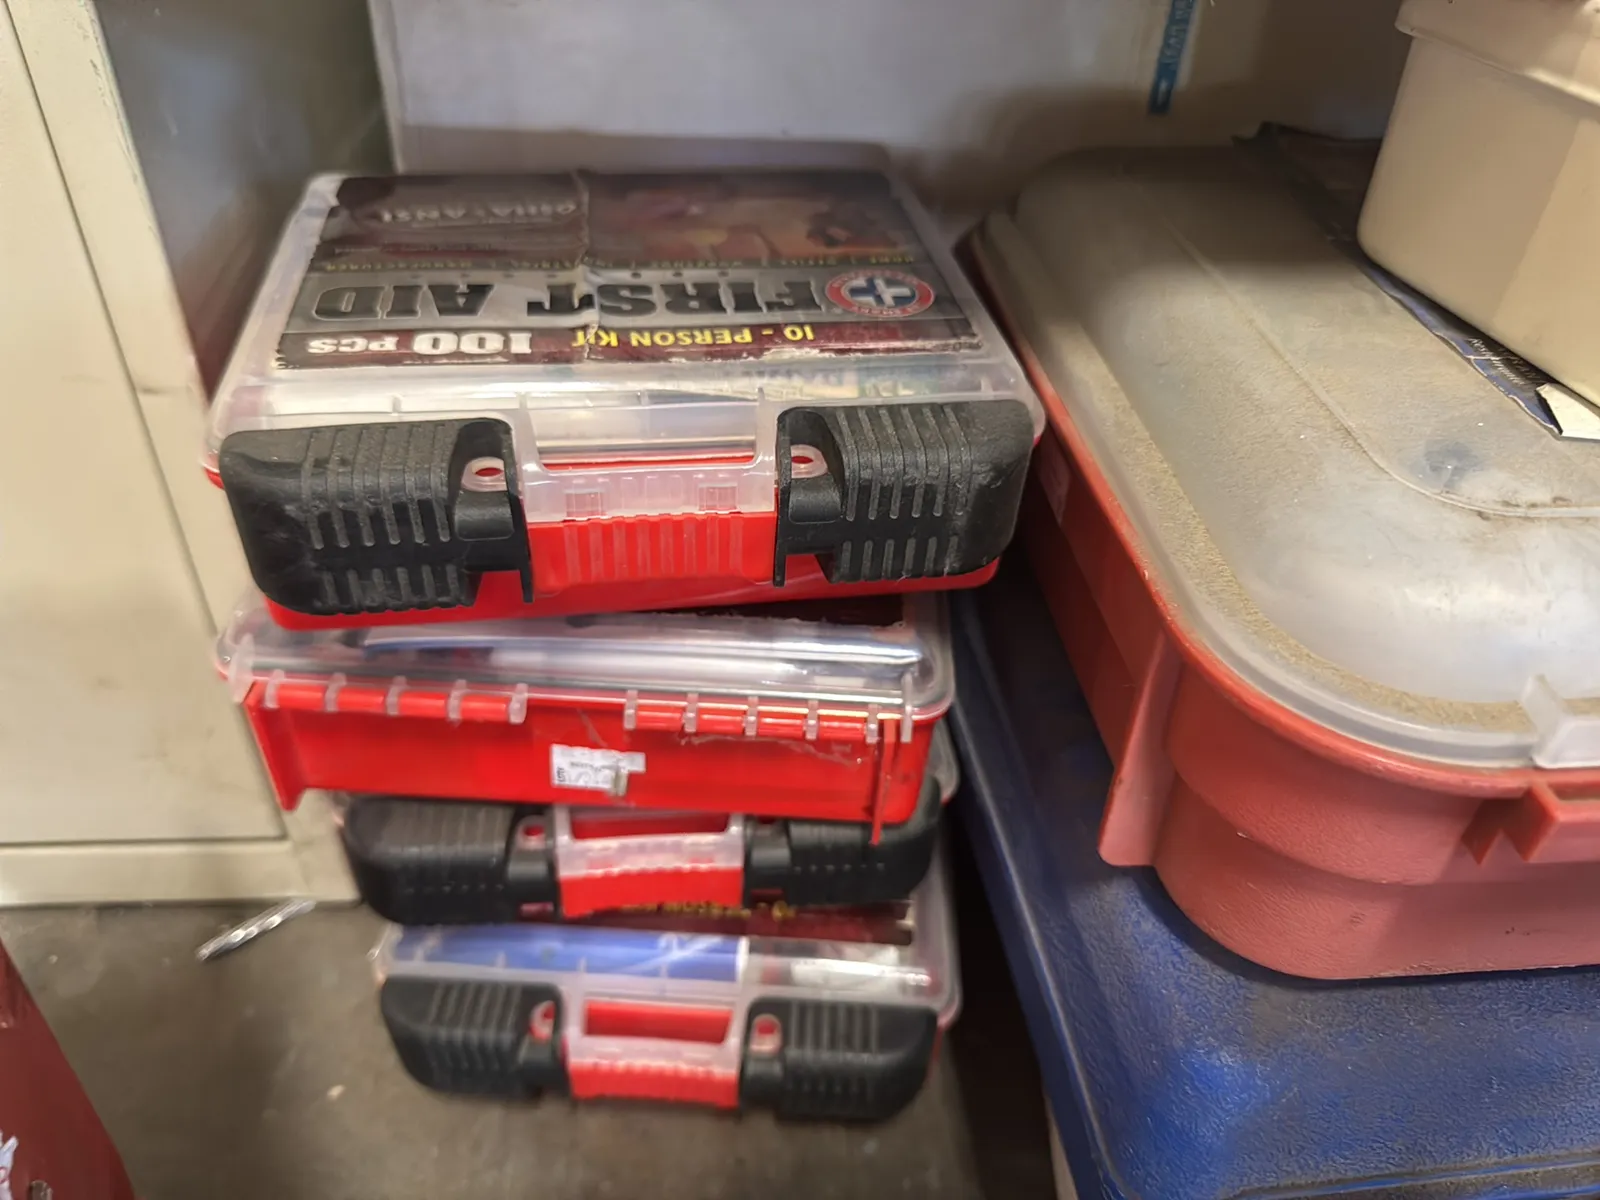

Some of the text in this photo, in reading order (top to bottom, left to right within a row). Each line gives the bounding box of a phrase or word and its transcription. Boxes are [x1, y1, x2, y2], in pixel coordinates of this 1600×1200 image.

[314, 283, 823, 319] FIRST AID
[571, 329, 619, 349] KIT
[629, 328, 754, 348] PERSON
[783, 324, 816, 342] 10
[307, 331, 533, 356] 100 PCS
